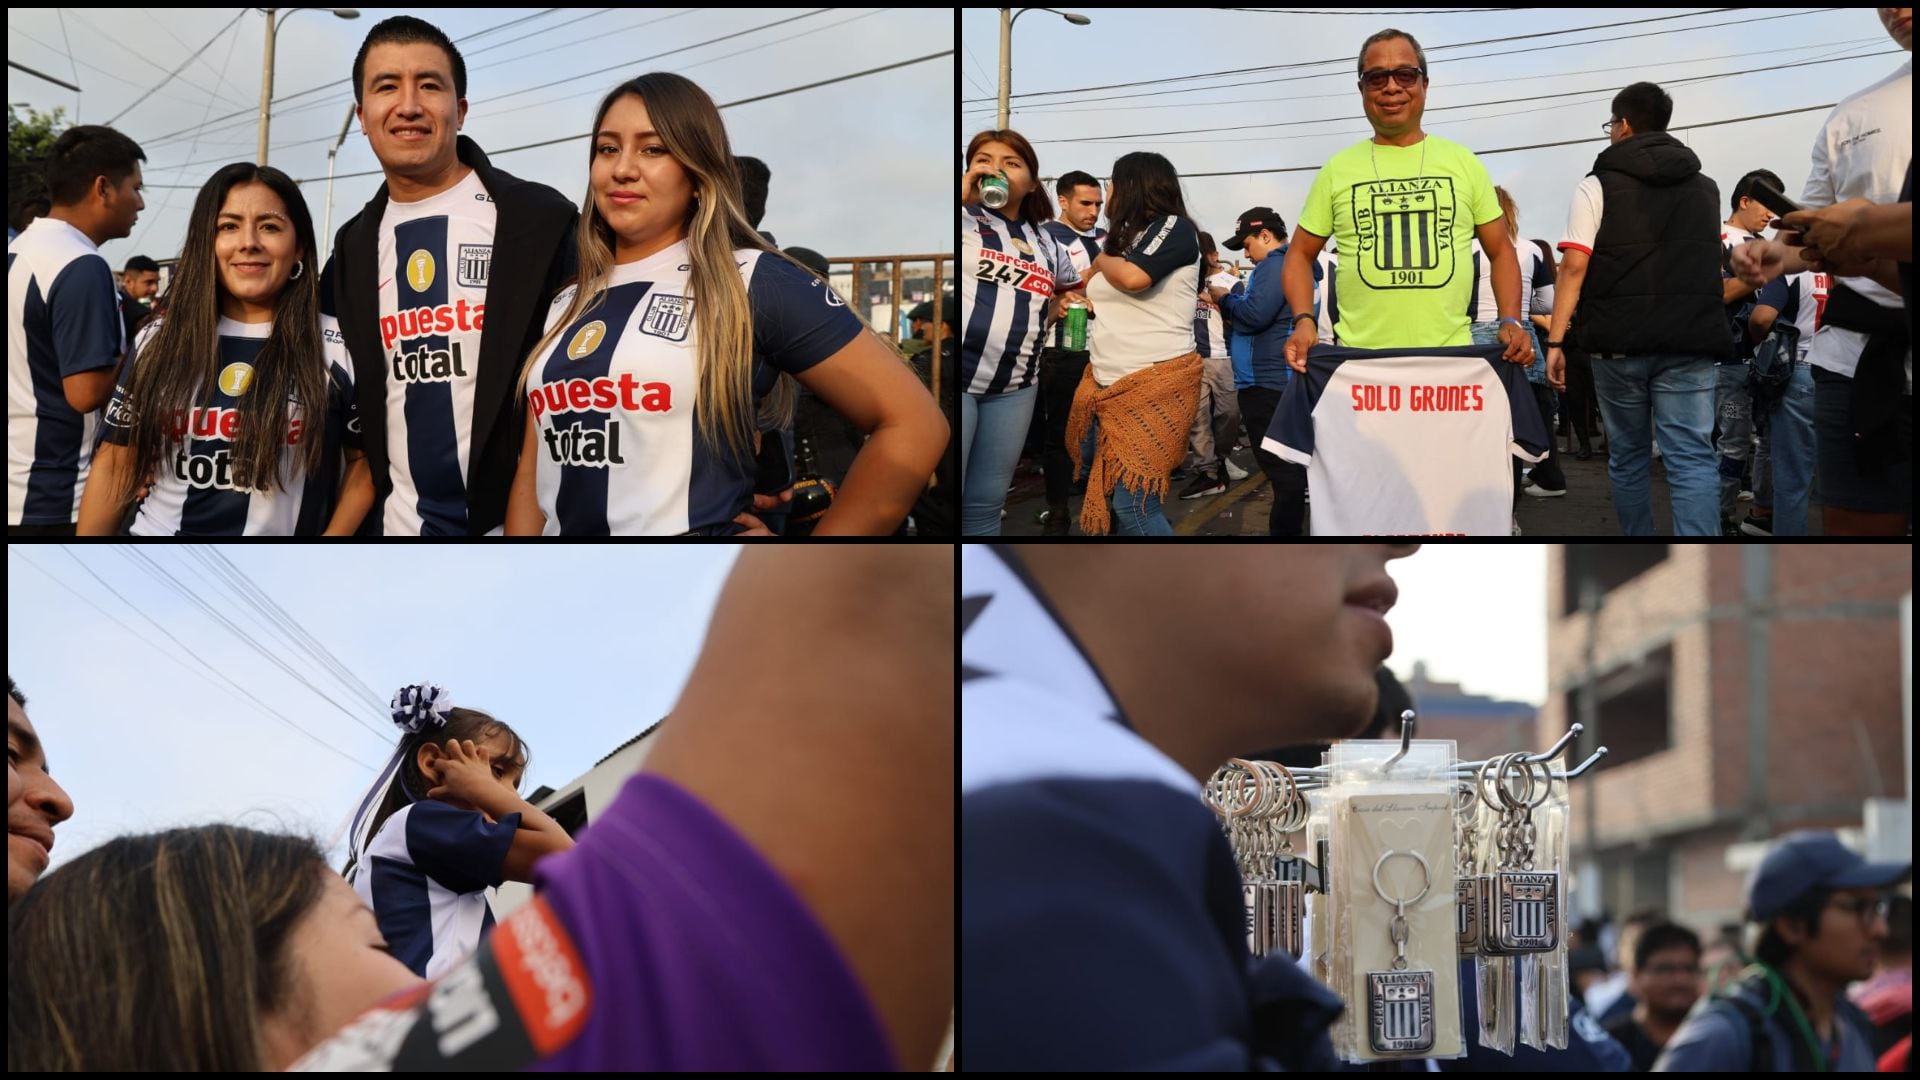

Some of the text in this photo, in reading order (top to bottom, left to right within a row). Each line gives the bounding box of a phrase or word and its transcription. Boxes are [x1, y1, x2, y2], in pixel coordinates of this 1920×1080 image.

[1367, 180, 1443, 194] ALIANZA
[1358, 207, 1374, 252] CLUB
[1438, 206, 1452, 251] LIMA
[1390, 271, 1424, 285] 1901
[393, 342, 467, 380] total
[529, 373, 672, 426] puesta
[1352, 384, 1484, 412] SOLO GRONES
[544, 421, 625, 464] total
[1505, 875, 1551, 884] ALIANZA
[1503, 893, 1513, 924] CLUB
[1546, 895, 1555, 924] LIMA
[1520, 938, 1539, 946] 1901
[1376, 975, 1426, 984] ALIANZA
[1374, 993, 1384, 1026] CLUB
[1421, 993, 1430, 1024] LIMA
[1392, 1040, 1414, 1049] 1901
